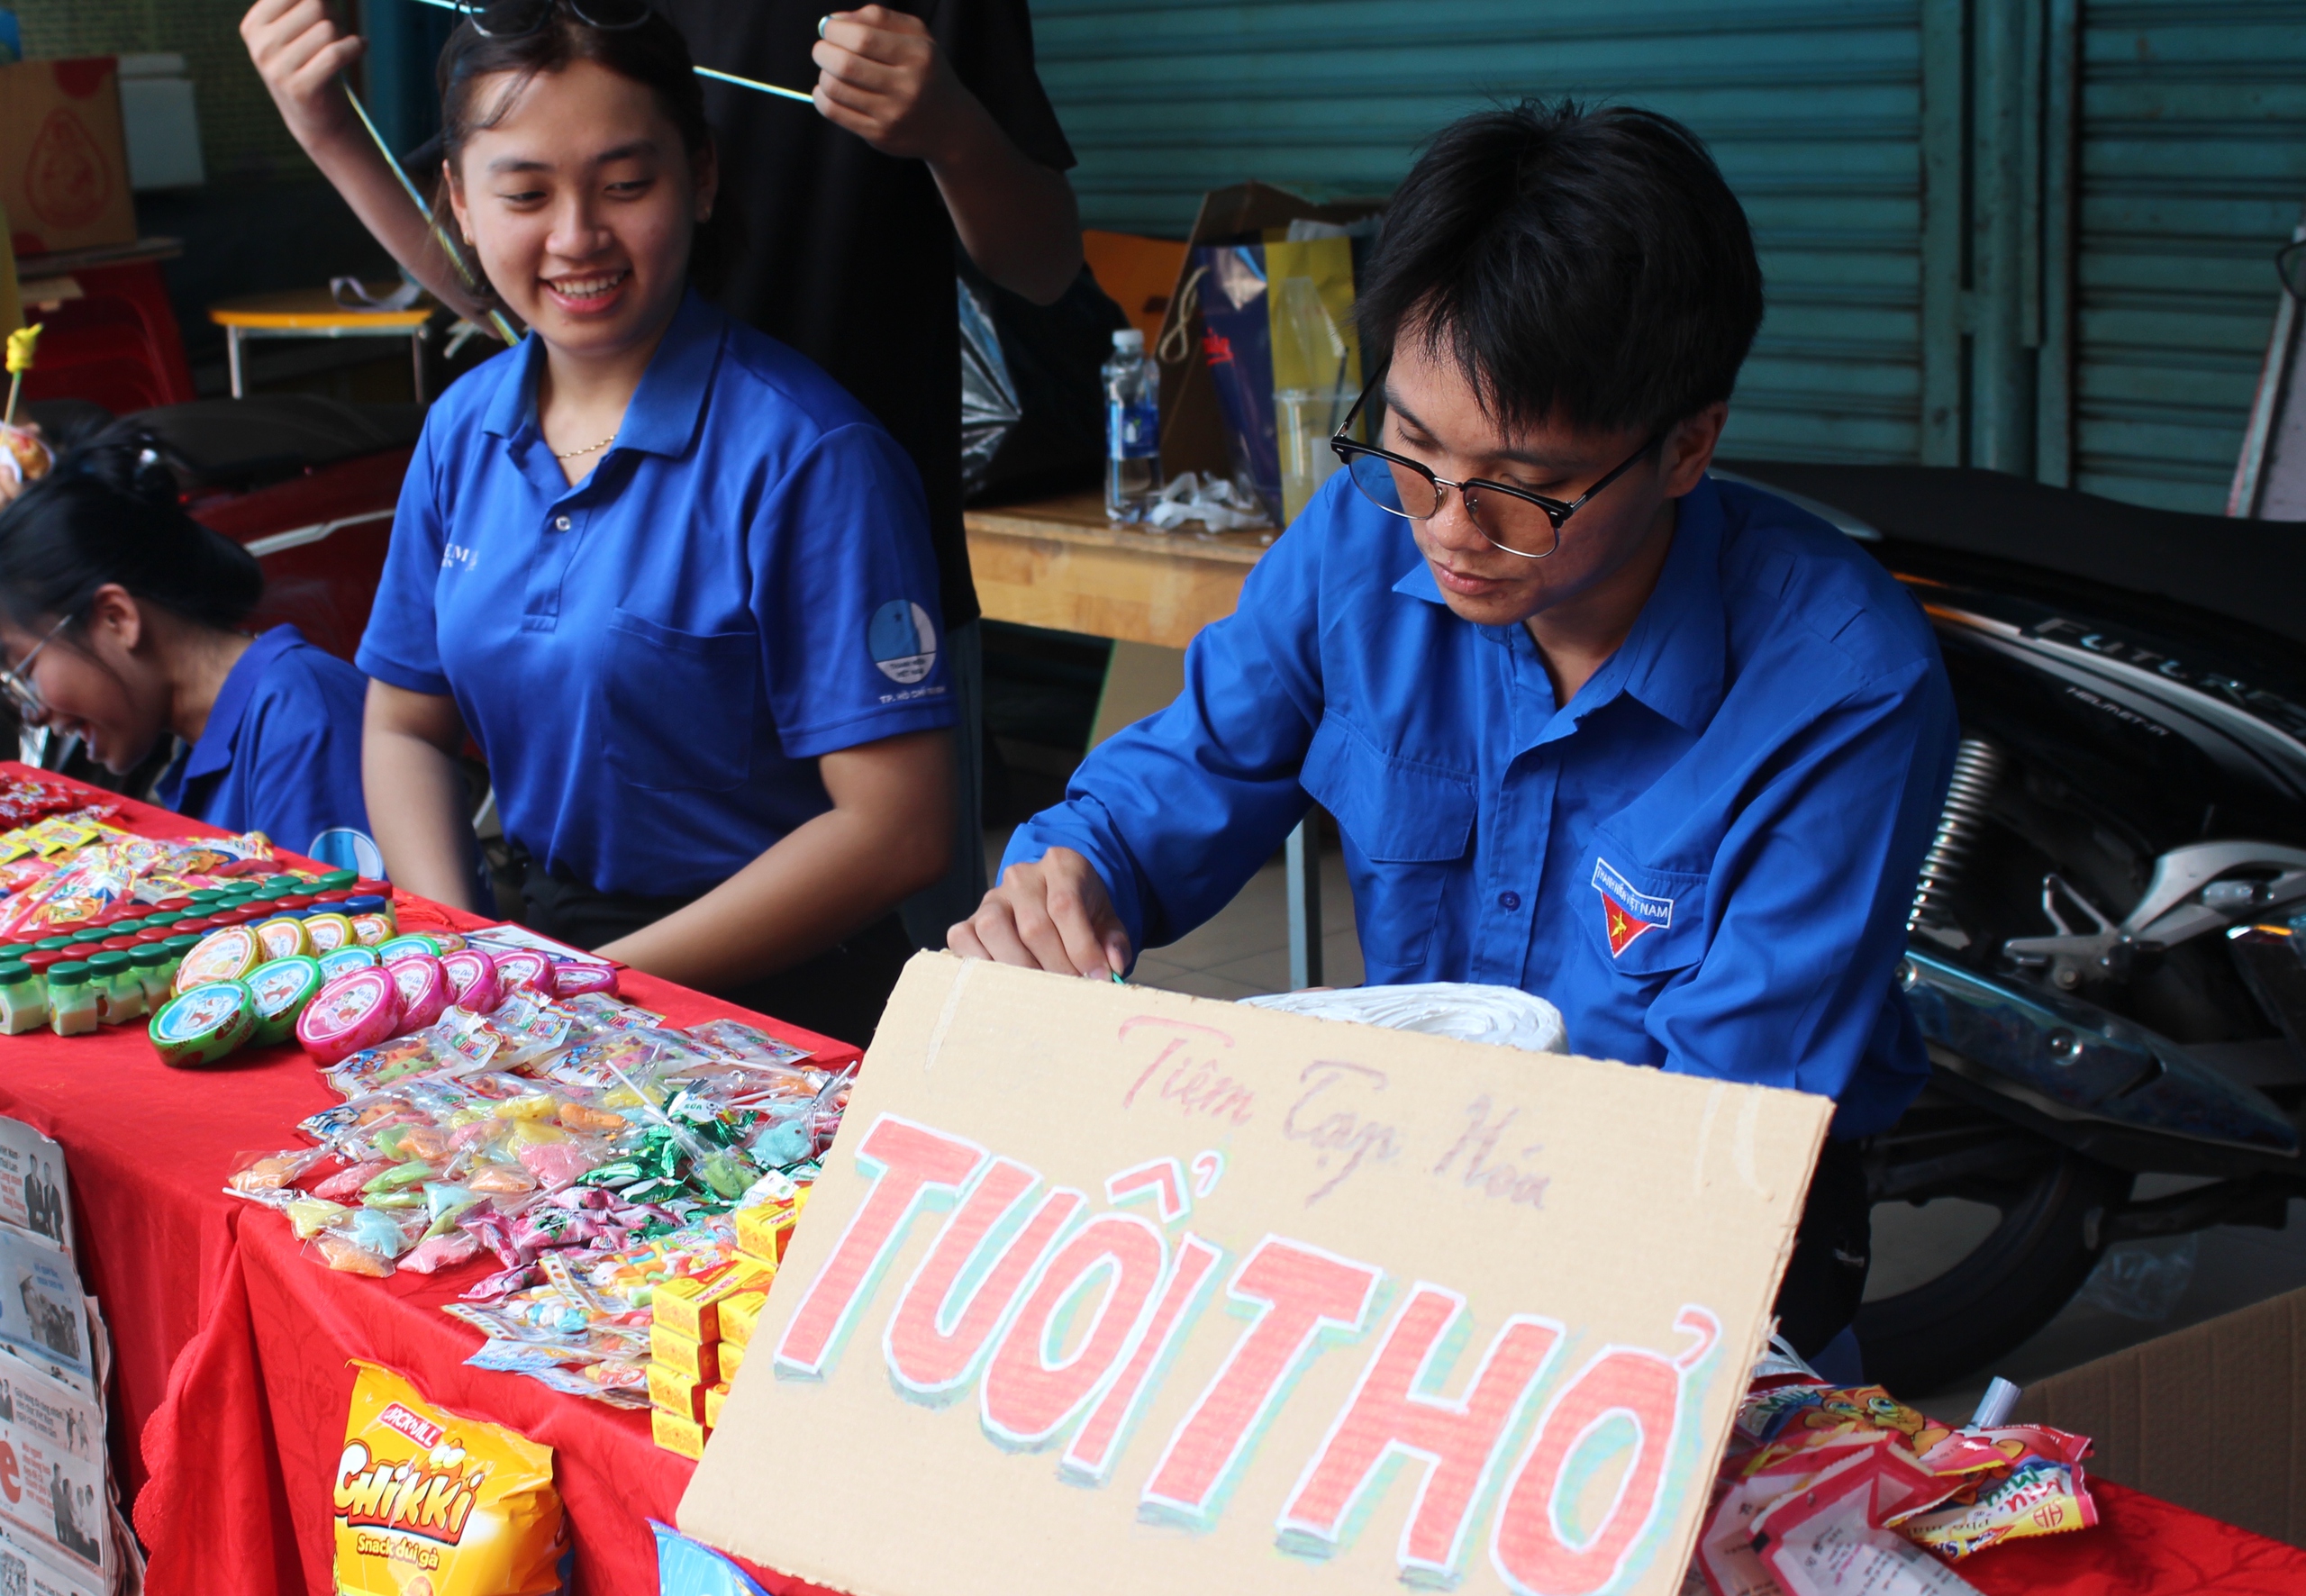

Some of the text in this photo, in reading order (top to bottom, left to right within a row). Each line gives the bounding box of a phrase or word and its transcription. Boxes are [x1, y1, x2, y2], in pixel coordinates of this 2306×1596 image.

[1640, 903, 1668, 918] NAM
[1118, 1015, 1257, 1126] Tiệm
[774, 1111, 1724, 1596] TUỔI THƠ
[358, 1534, 440, 1571] Snack đùi gà
